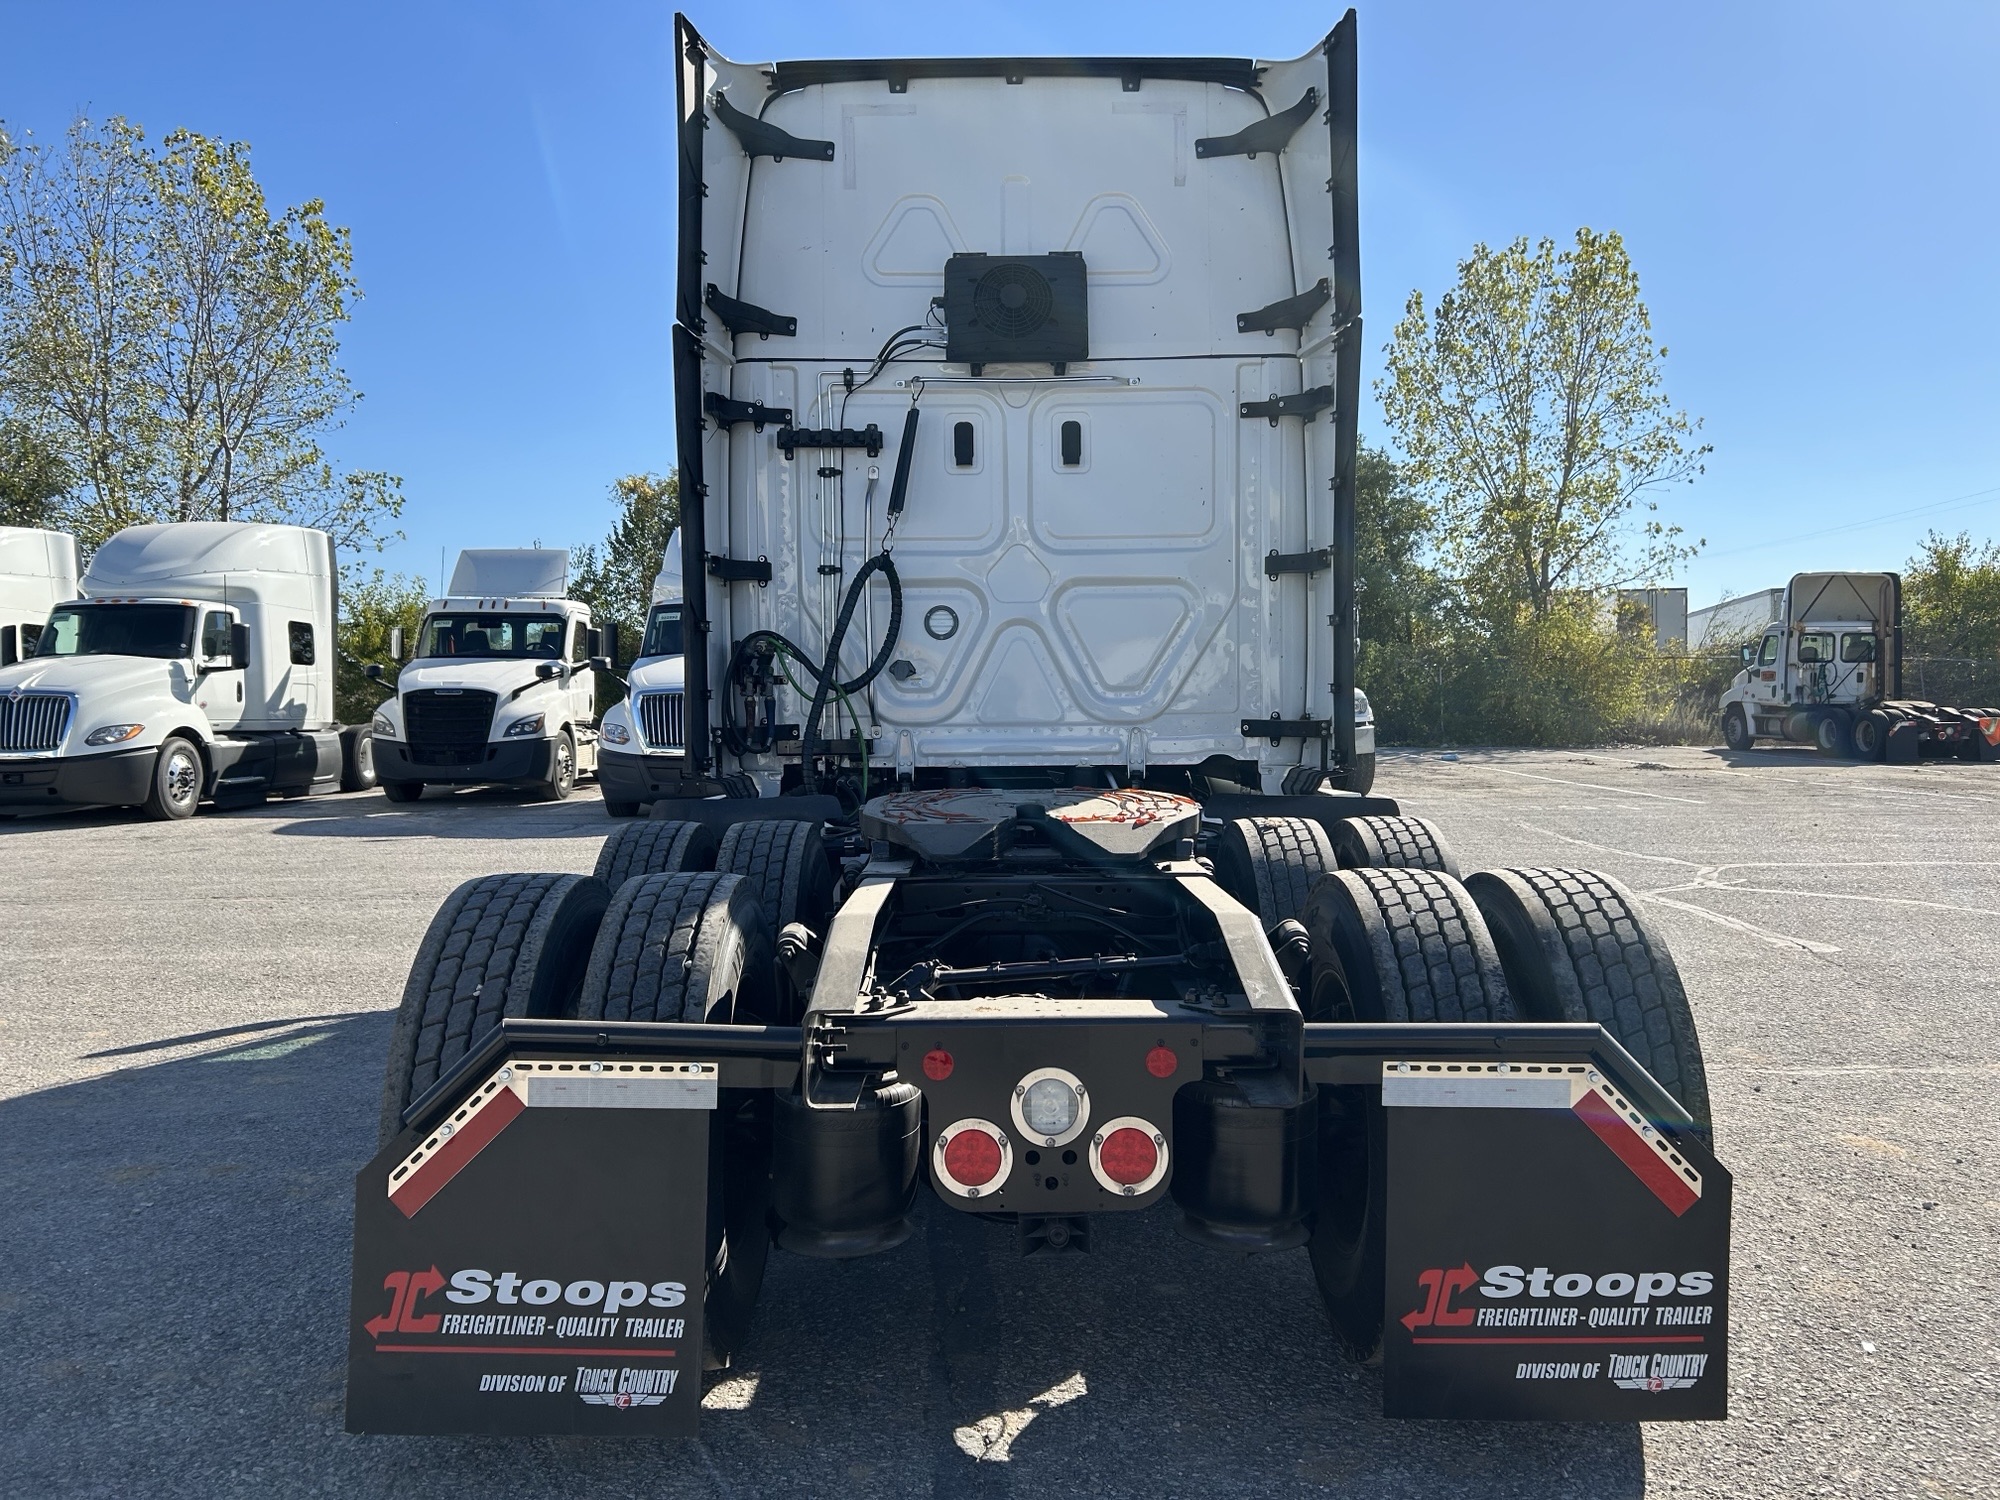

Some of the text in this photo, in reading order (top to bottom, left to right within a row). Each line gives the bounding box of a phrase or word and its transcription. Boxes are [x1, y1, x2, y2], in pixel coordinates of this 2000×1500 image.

[445, 1269, 687, 1313] Stoops
[1479, 1265, 1714, 1303] Stoops
[1655, 1306, 1712, 1325] TRAILER
[625, 1318, 685, 1339] TRAILER
[1516, 1363, 1579, 1379] DIVISION
[1582, 1363, 1601, 1379] OF
[479, 1374, 546, 1393] DIVISION
[548, 1375, 567, 1393] OF
